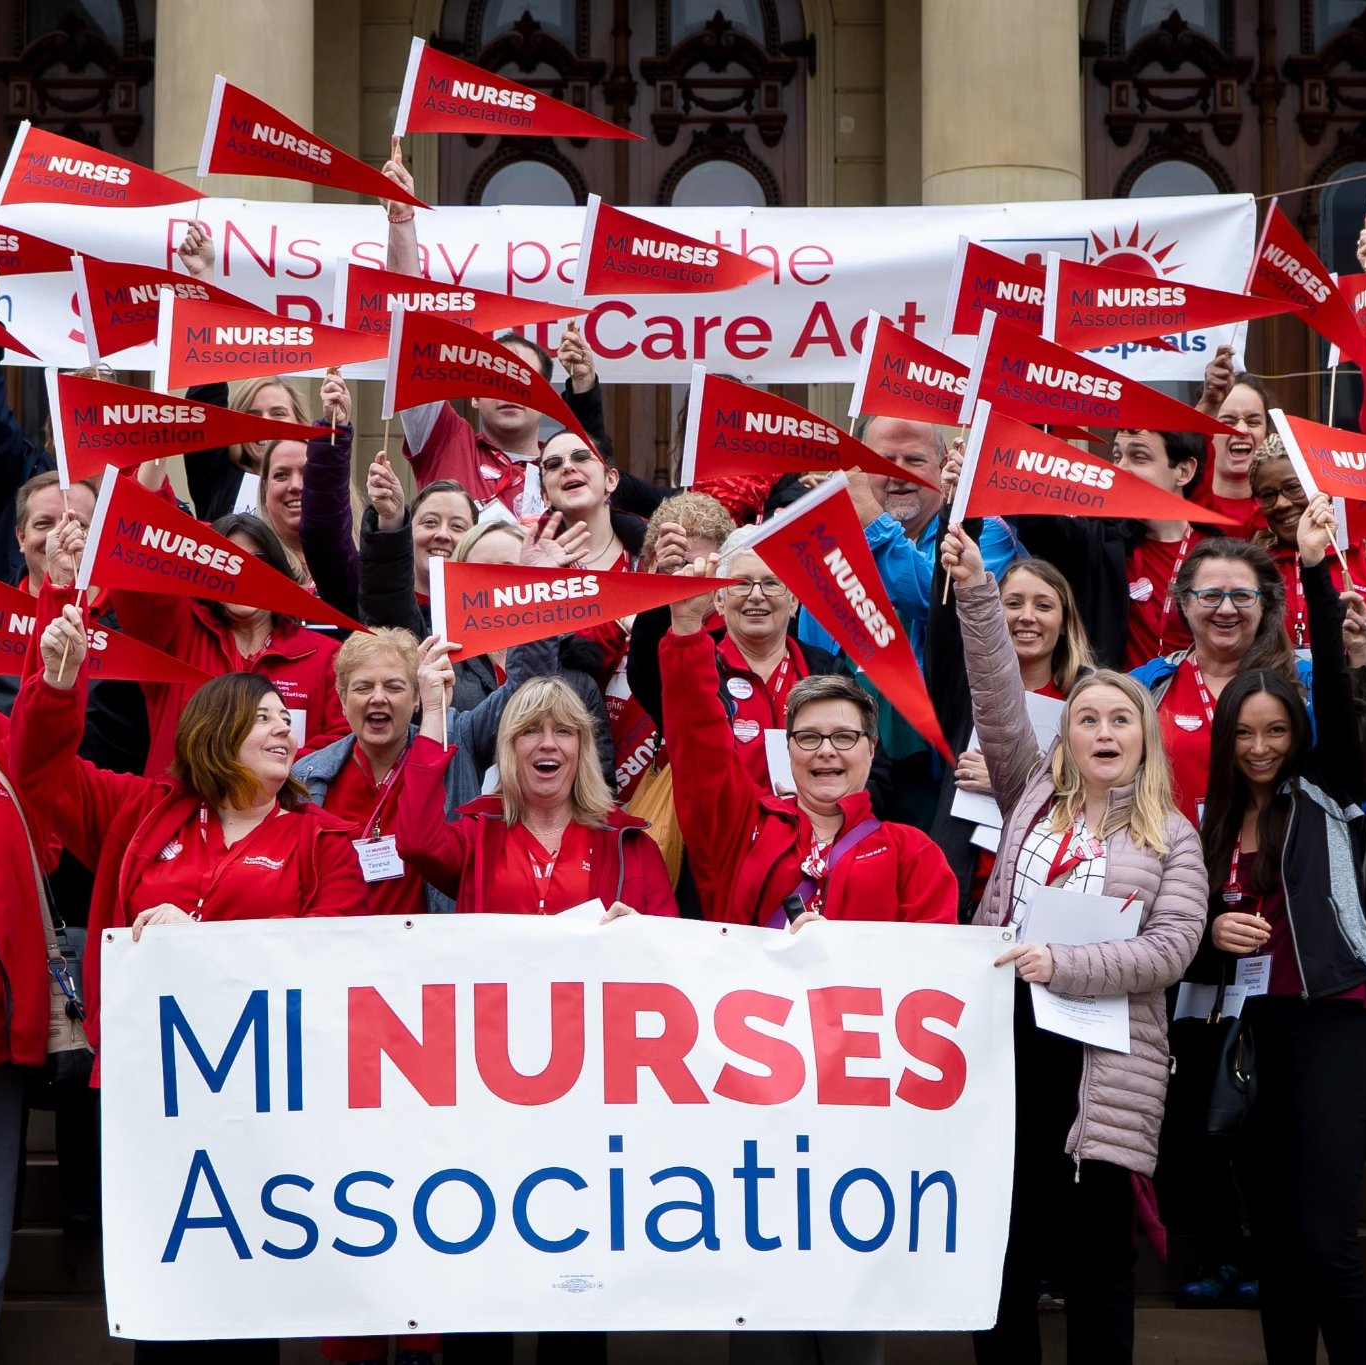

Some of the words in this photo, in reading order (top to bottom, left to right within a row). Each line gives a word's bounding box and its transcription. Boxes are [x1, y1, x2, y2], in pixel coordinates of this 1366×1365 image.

[451, 80, 538, 112] NURSES
[252, 122, 332, 164] NURSES
[47, 156, 132, 186] NURSES
[631, 238, 720, 267] NURSES
[1262, 243, 1332, 303] NURSES
[1096, 287, 1187, 308] NURSES
[214, 326, 315, 346] NURSES
[589, 300, 773, 361] Care
[439, 344, 532, 386] NURSES
[1026, 362, 1123, 401] NURSES
[102, 404, 207, 426] NURSES
[745, 411, 840, 446] NURSES
[1015, 449, 1116, 491] NURSES
[140, 524, 245, 576] NURSES
[493, 575, 600, 609] NURSES
[822, 546, 896, 649] NURSES
[158, 988, 303, 1119] MI
[346, 981, 968, 1111] NURSES
[159, 1134, 958, 1264] Association
